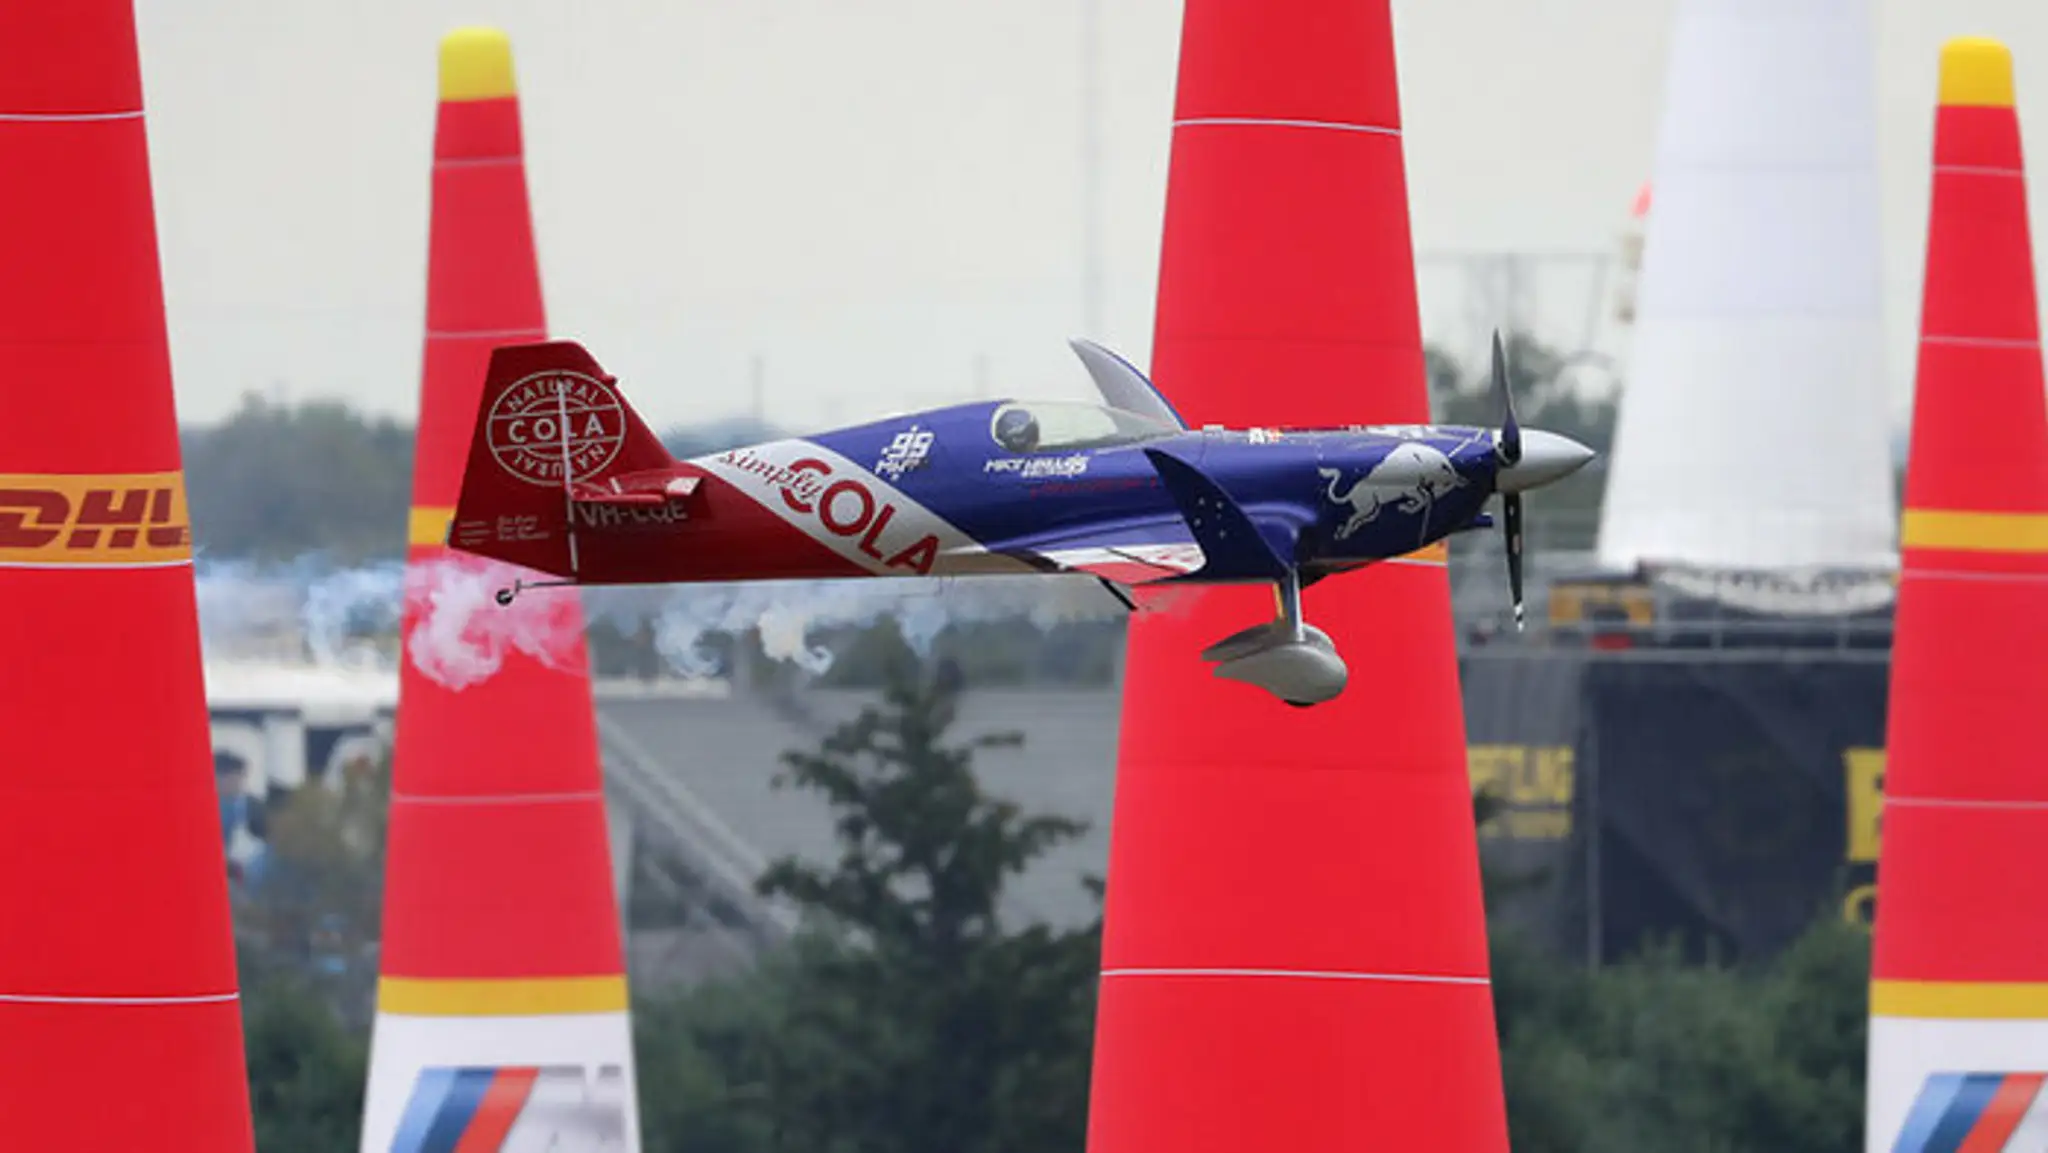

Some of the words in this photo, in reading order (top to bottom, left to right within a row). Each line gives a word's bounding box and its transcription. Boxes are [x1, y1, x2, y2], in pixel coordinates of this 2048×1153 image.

[508, 412, 605, 443] COLA
[513, 444, 606, 477] NAURAL
[0, 488, 190, 548] DHL
[780, 458, 940, 576] COLA
